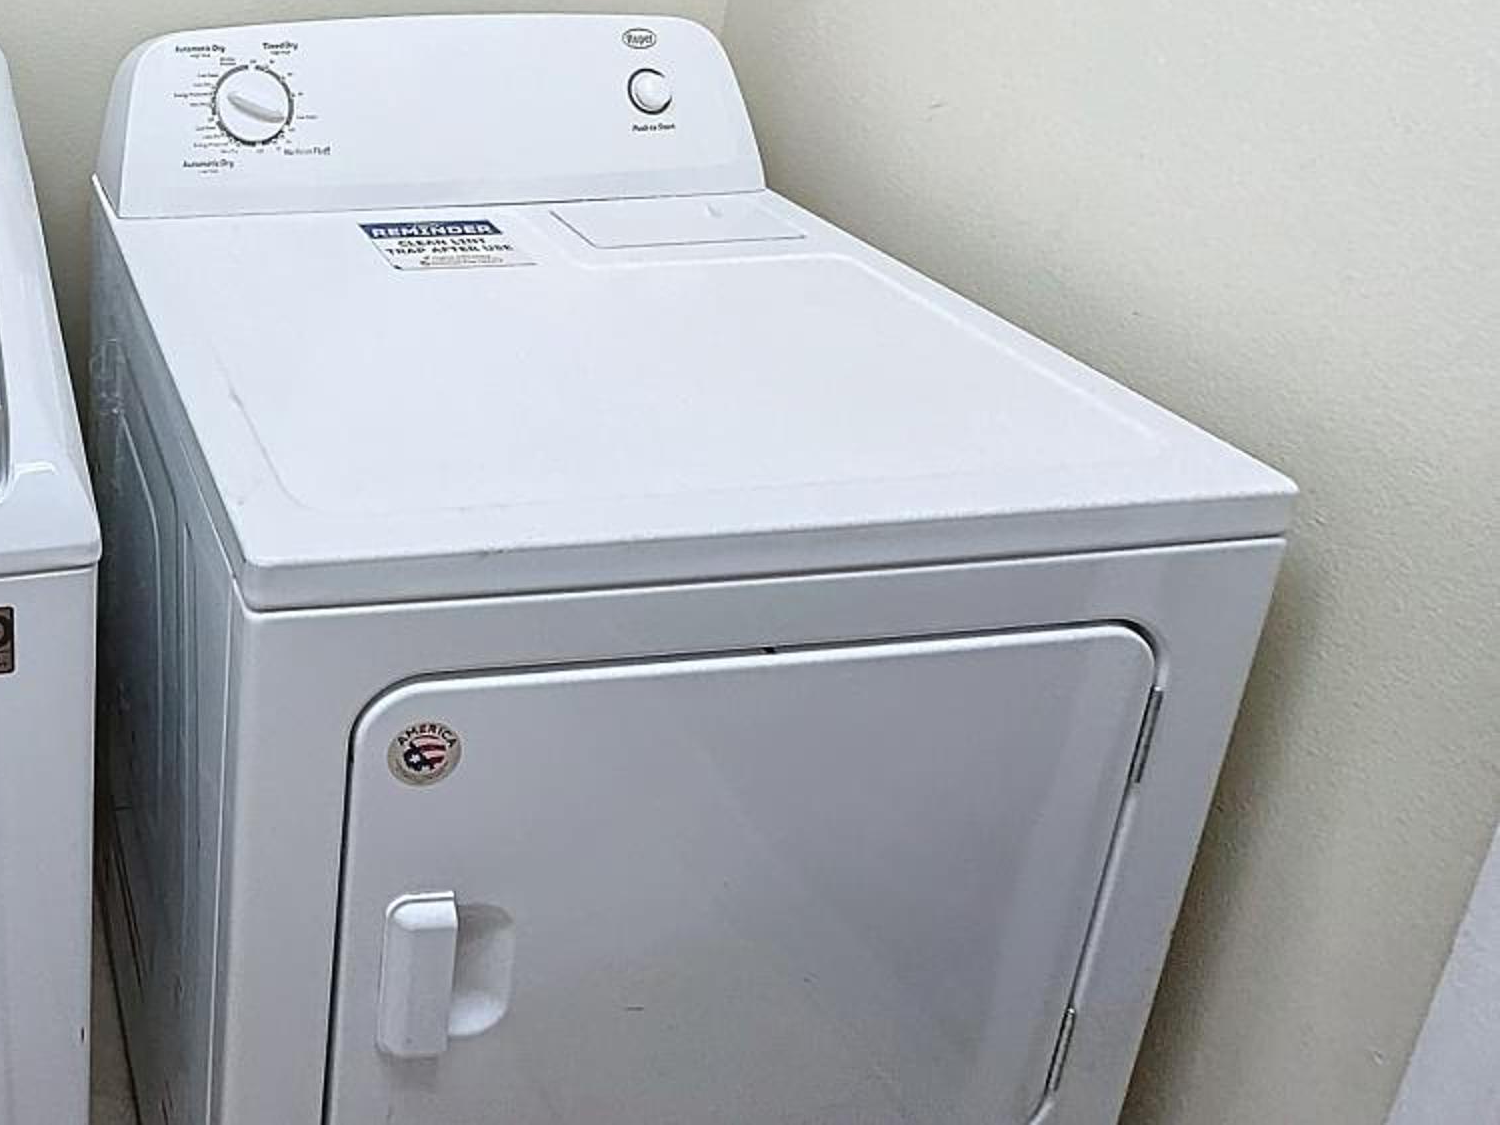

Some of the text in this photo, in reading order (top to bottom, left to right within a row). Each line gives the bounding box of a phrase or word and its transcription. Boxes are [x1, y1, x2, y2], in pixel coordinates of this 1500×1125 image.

[212, 44, 226, 54] Dry
[371, 224, 492, 237] REMINDER
[397, 237, 486, 247] CLEAN LINT
[385, 244, 514, 255] TRAP AFTER USE
[398, 723, 457, 748] AMERICA
